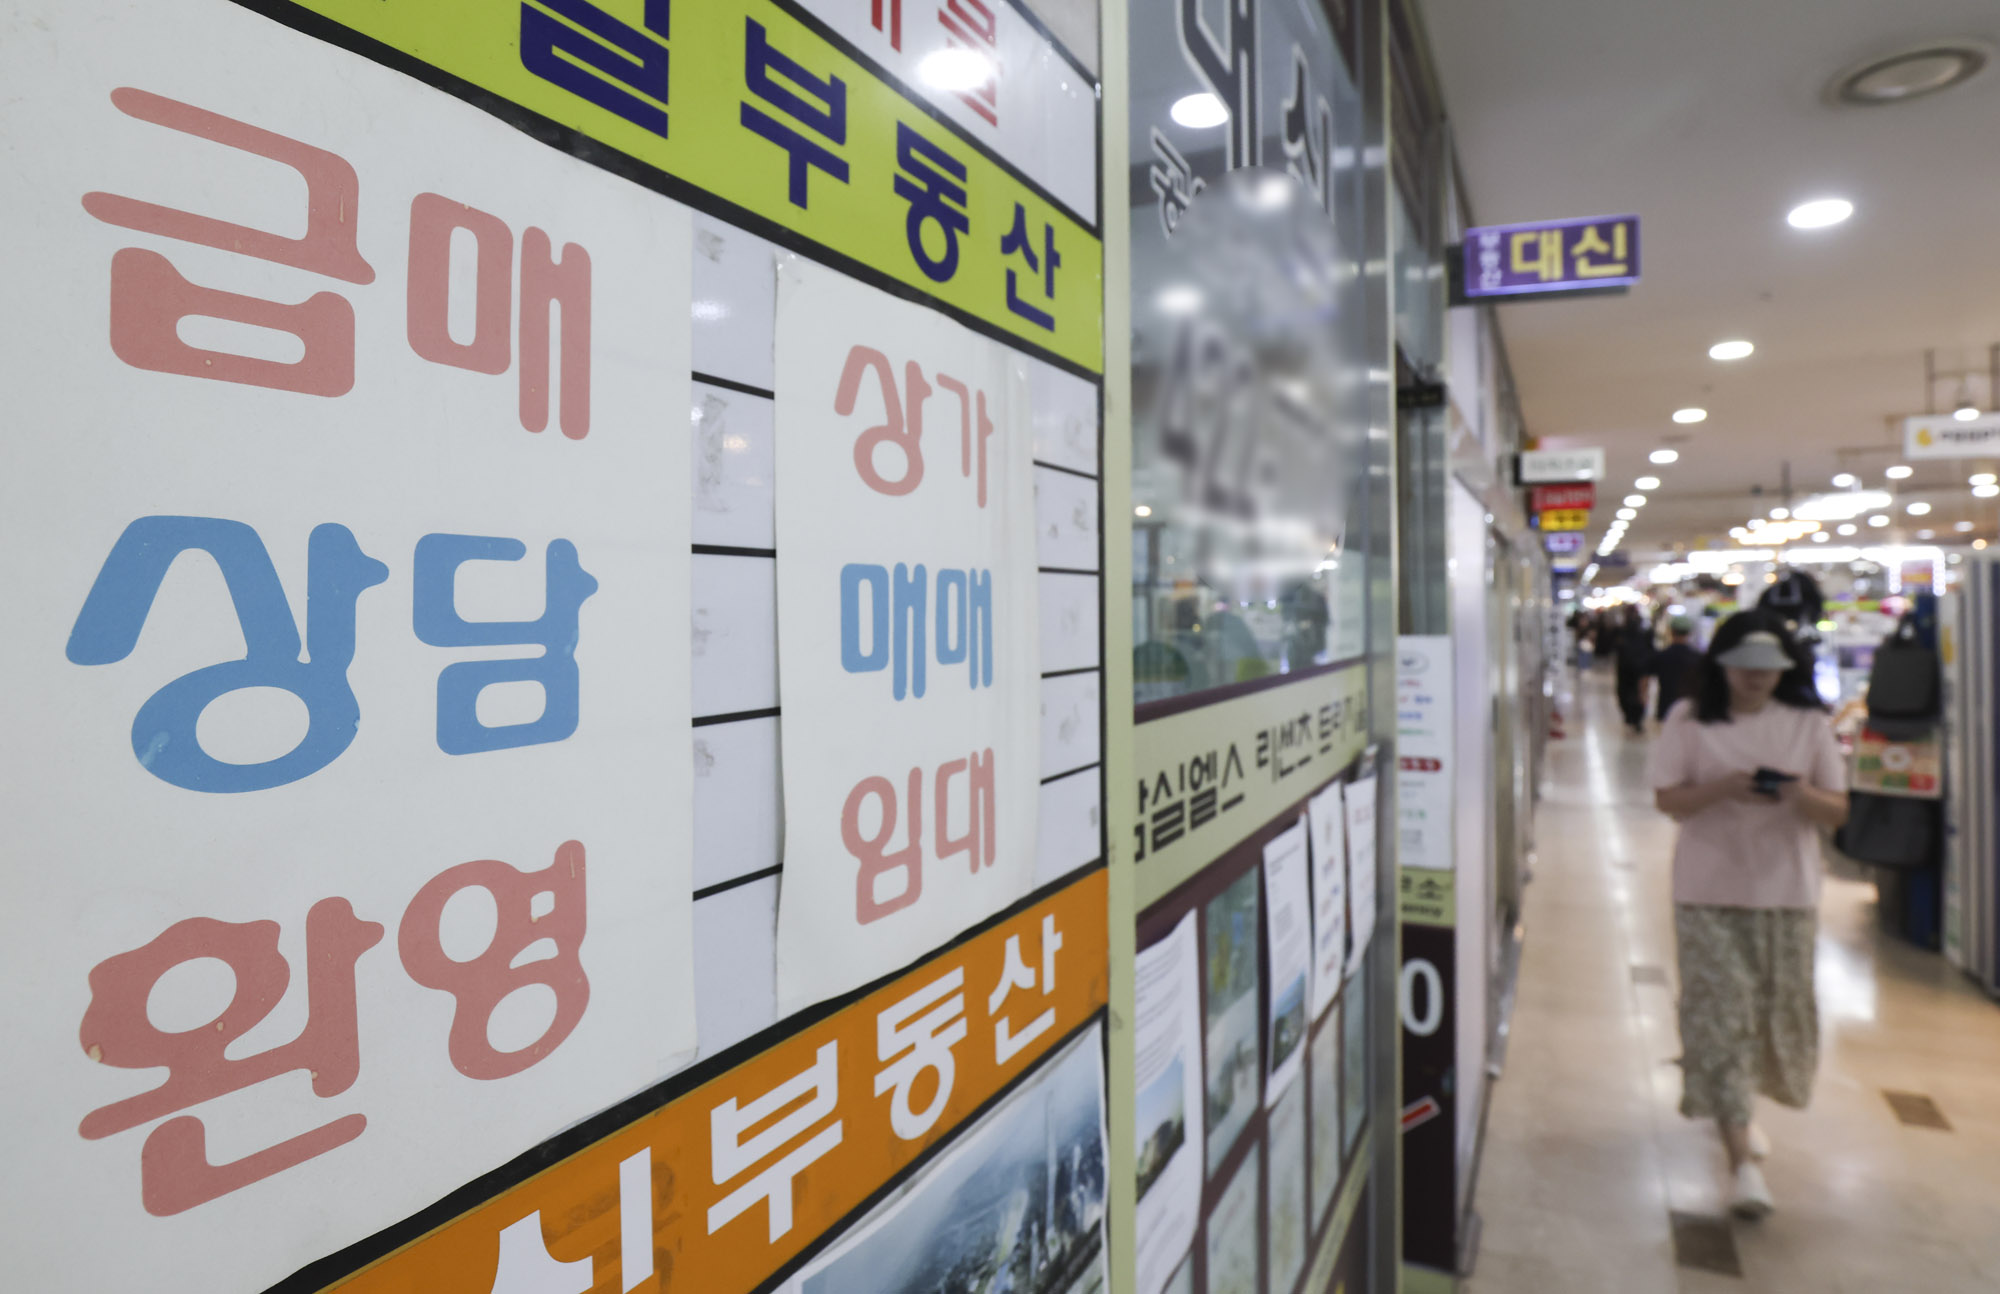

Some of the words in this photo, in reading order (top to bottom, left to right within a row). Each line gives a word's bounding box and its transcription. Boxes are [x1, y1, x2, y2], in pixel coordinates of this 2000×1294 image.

[81, 86, 592, 440] 급매
[1510, 222, 1628, 282] 대신
[834, 344, 994, 509] 상가
[66, 515, 599, 793] 상담
[840, 562, 993, 701] 매매
[840, 746, 996, 926] 임대
[78, 839, 591, 1218] 환영
